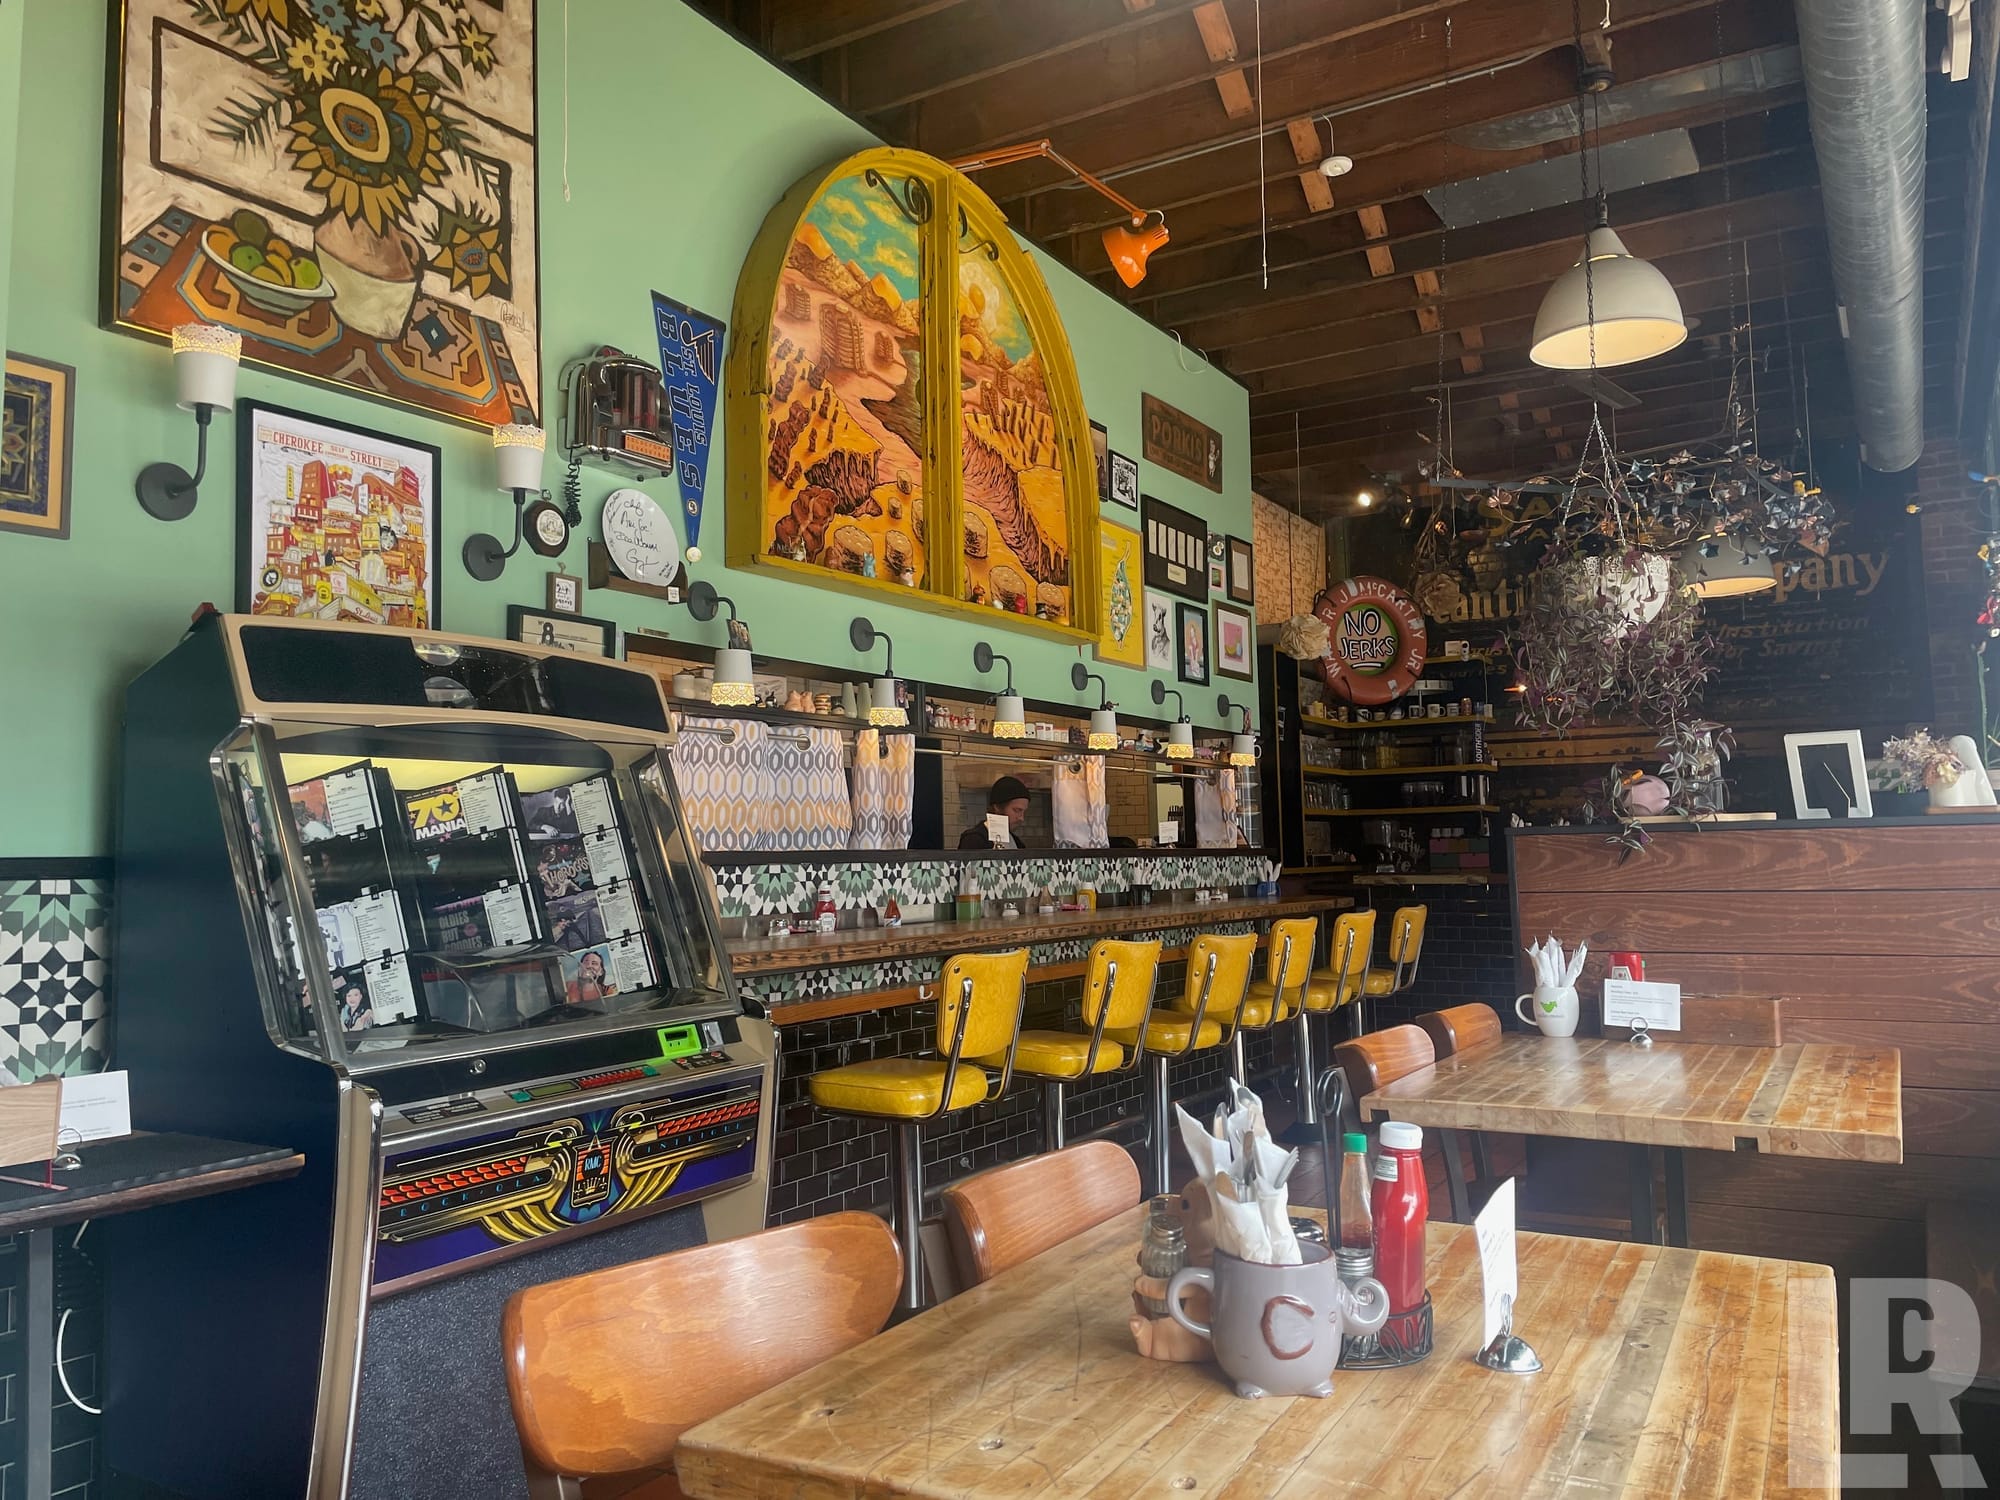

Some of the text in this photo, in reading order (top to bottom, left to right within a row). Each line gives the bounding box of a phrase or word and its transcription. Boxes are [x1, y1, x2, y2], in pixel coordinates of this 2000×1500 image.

[656, 307, 702, 491] BLUES
[687, 382, 708, 447] LOUIS
[273, 431, 324, 454] CHEROKEE
[350, 450, 383, 467] STREET
[1344, 609, 1382, 637] NO
[1338, 636, 1396, 661] JERKS
[416, 819, 466, 841] MANIA
[438, 910, 470, 929] OLDIES
[441, 928, 459, 943] BUT
[584, 1154, 602, 1171] RMC
[1260, 1294, 1316, 1361] C
